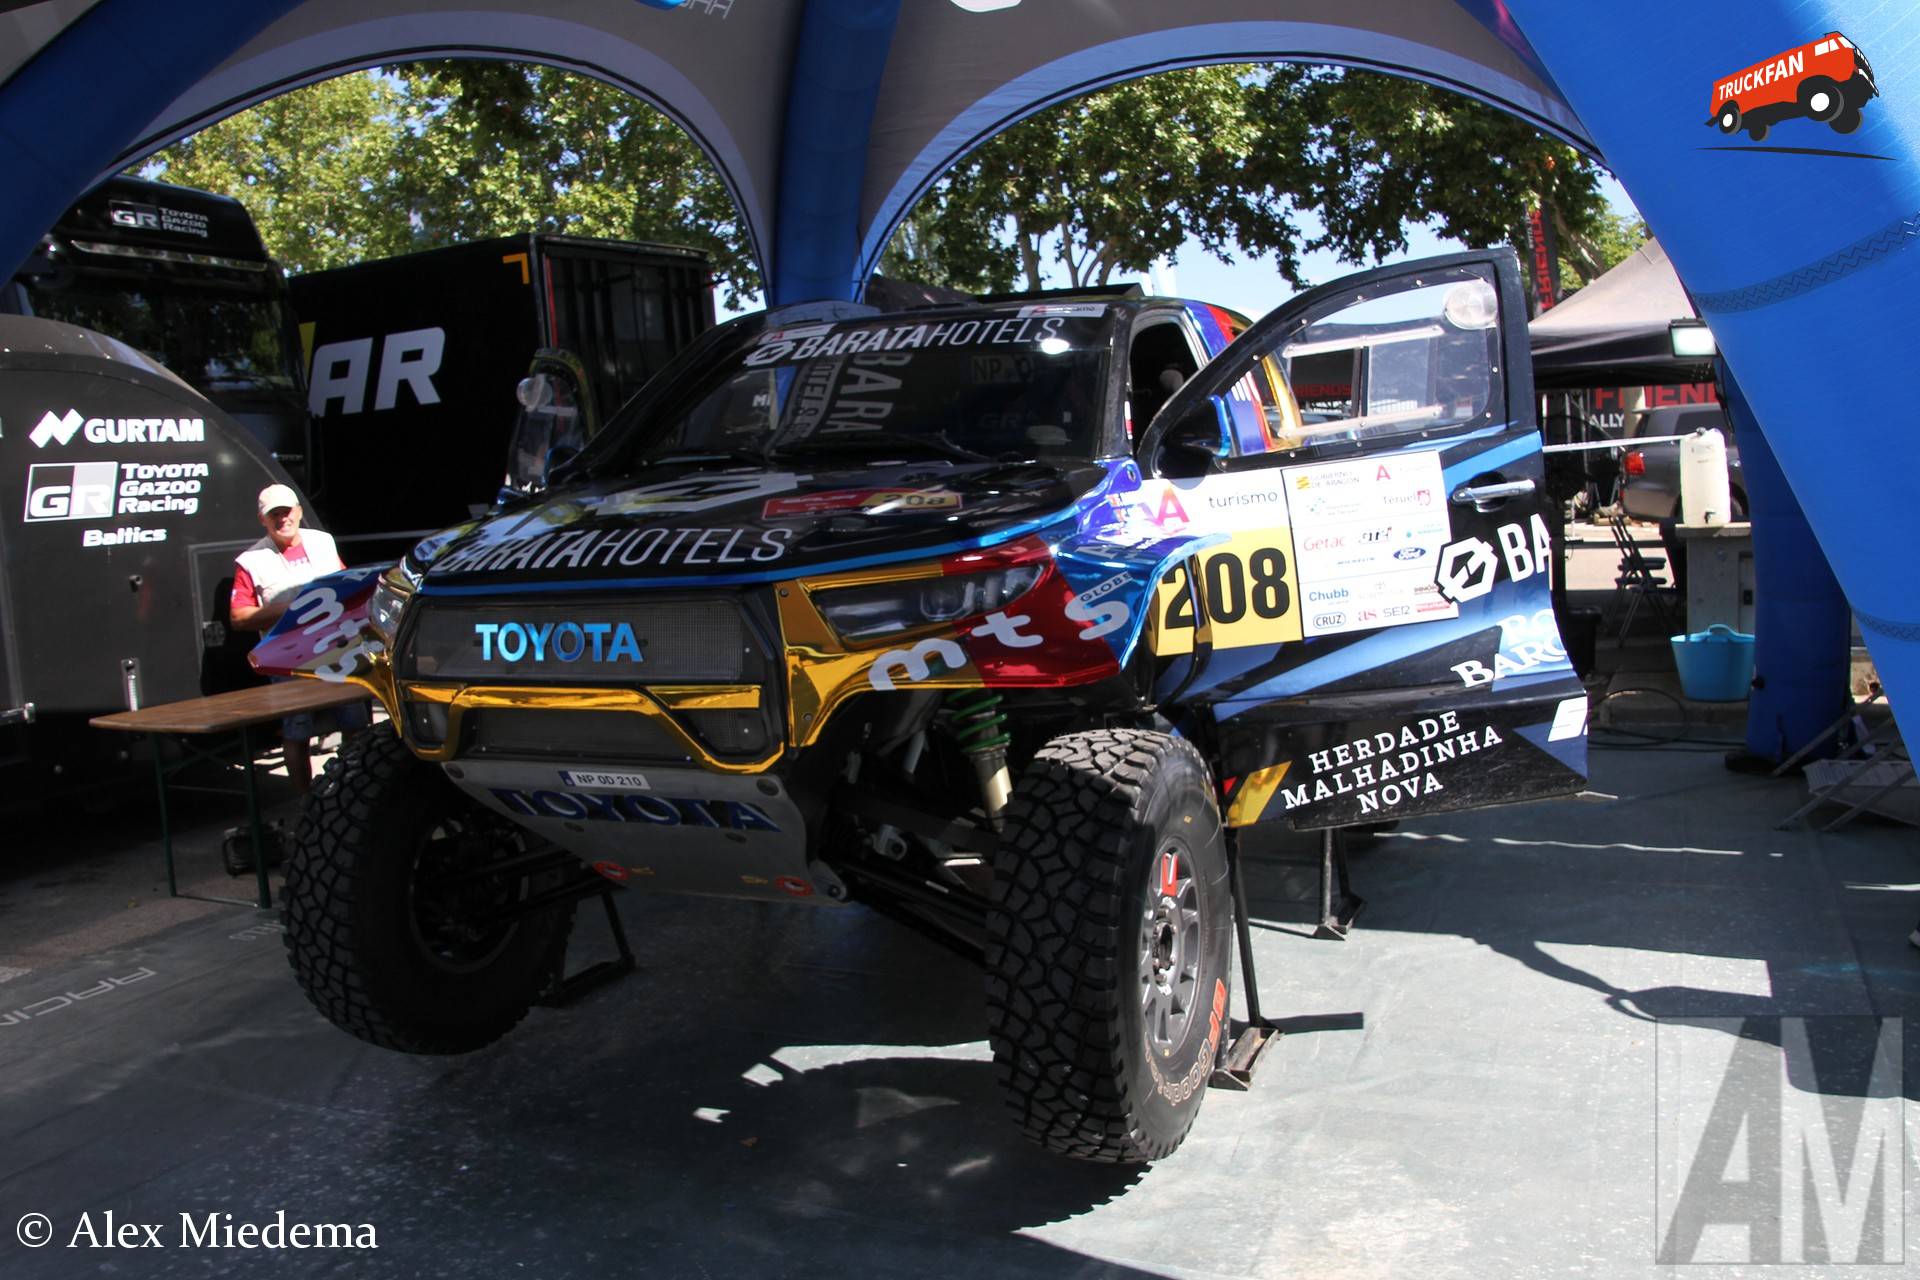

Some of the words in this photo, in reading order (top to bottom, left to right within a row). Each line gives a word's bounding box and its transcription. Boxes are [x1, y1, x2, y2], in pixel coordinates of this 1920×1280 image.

[111, 209, 158, 228] GR
[159, 206, 209, 222] TOYOTA
[161, 215, 207, 229] GAZOO
[163, 223, 209, 238] Racing
[84, 418, 205, 443] GURTAM
[120, 463, 209, 480] TOYOTA
[1376, 464, 1391, 482] A
[120, 480, 201, 497] GAZOO
[30, 484, 112, 517] GR
[118, 496, 199, 515] Racing
[1208, 491, 1278, 509] turismo
[83, 527, 167, 547] Baltics
[1161, 547, 1290, 630] 208
[1309, 587, 1350, 603] Chubb
[1315, 614, 1342, 628] CRUZ
[475, 621, 644, 663] TOYOTA
[868, 600, 1131, 692] mts
[1308, 711, 1461, 774] HERDADE
[1281, 726, 1502, 810] MALHADINHA
[576, 773, 595, 784] NP
[617, 775, 643, 787] 210
[1356, 772, 1444, 814] NOVA
[487, 788, 782, 833] TOYOTA
